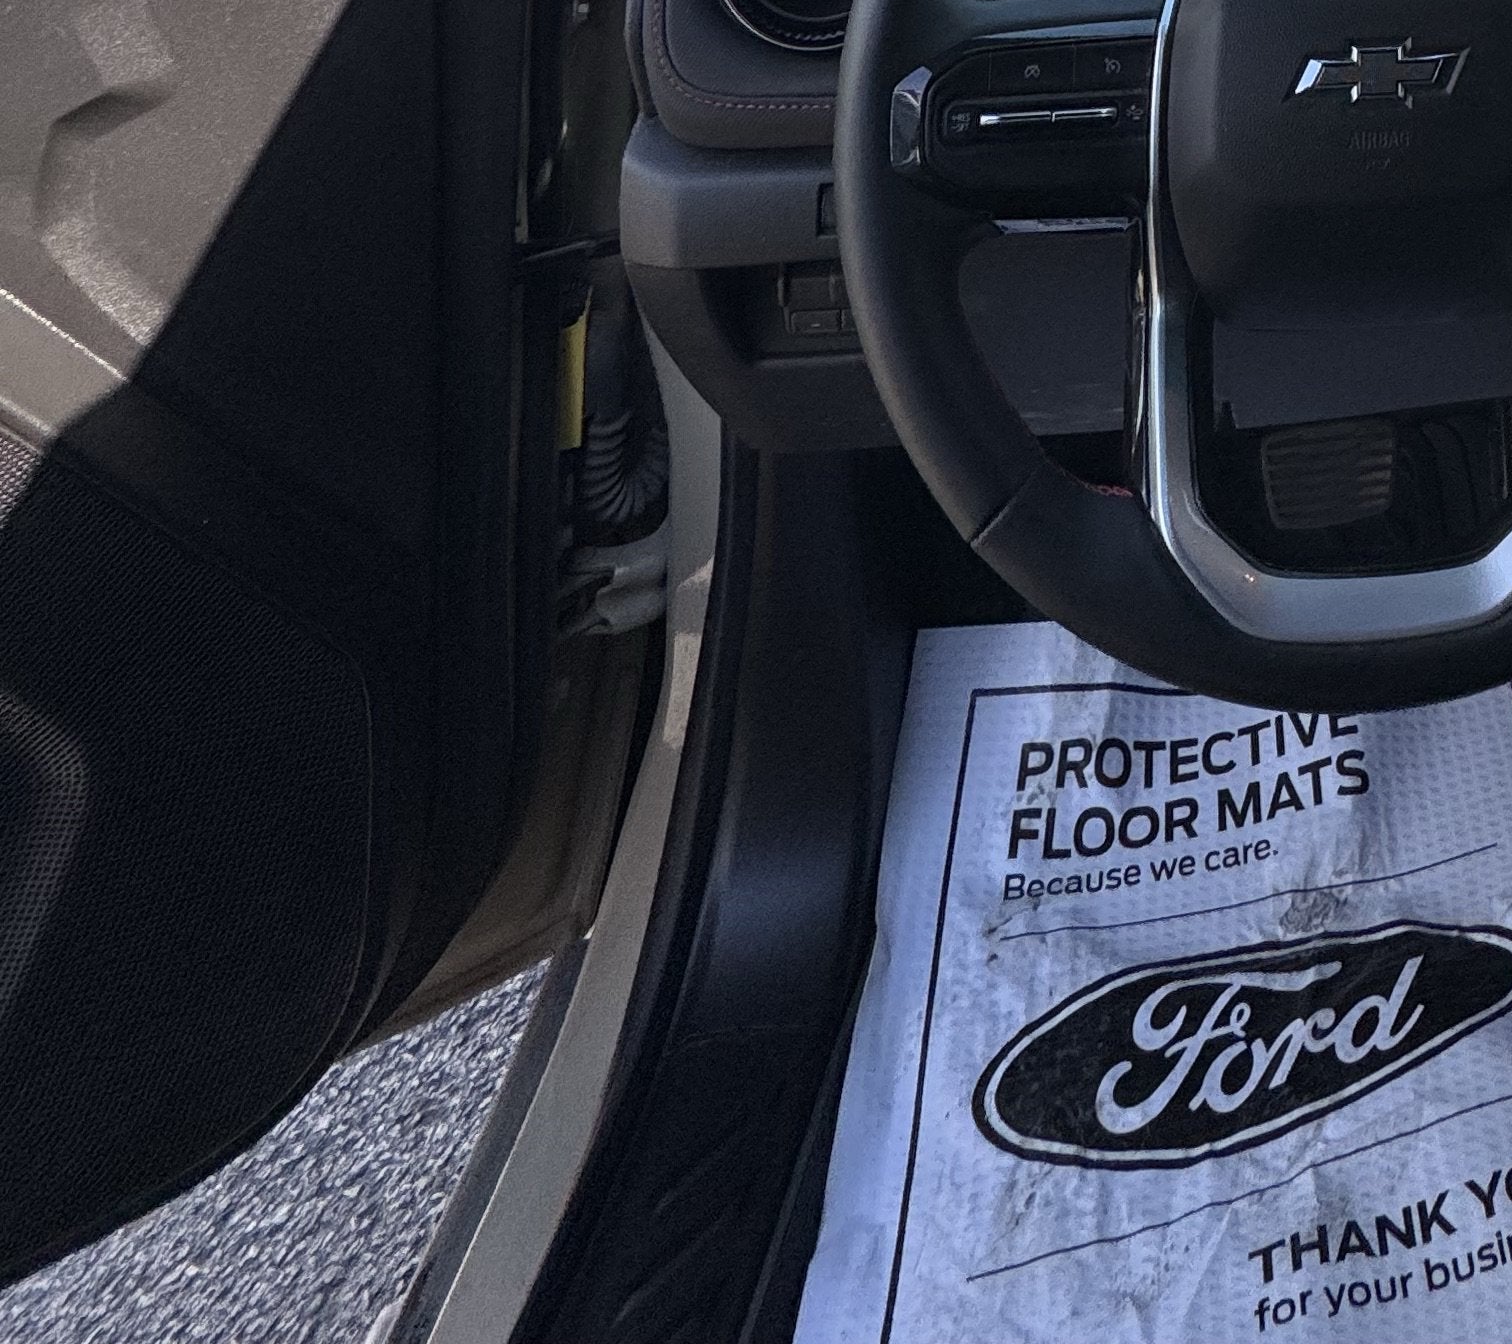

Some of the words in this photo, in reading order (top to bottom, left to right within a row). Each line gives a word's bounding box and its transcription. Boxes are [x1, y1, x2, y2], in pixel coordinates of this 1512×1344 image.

[1015, 712, 1360, 792] PROTECTIVE
[1006, 796, 1199, 860] FLOOR
[1216, 749, 1370, 832] MATS
[1002, 863, 1142, 902] Because
[1149, 854, 1196, 882] we
[1204, 838, 1279, 873] care.
[1095, 953, 1425, 1135] Ford
[1247, 1189, 1458, 1284] THANK
[1253, 1288, 1313, 1333] for
[1322, 1271, 1413, 1319] your
